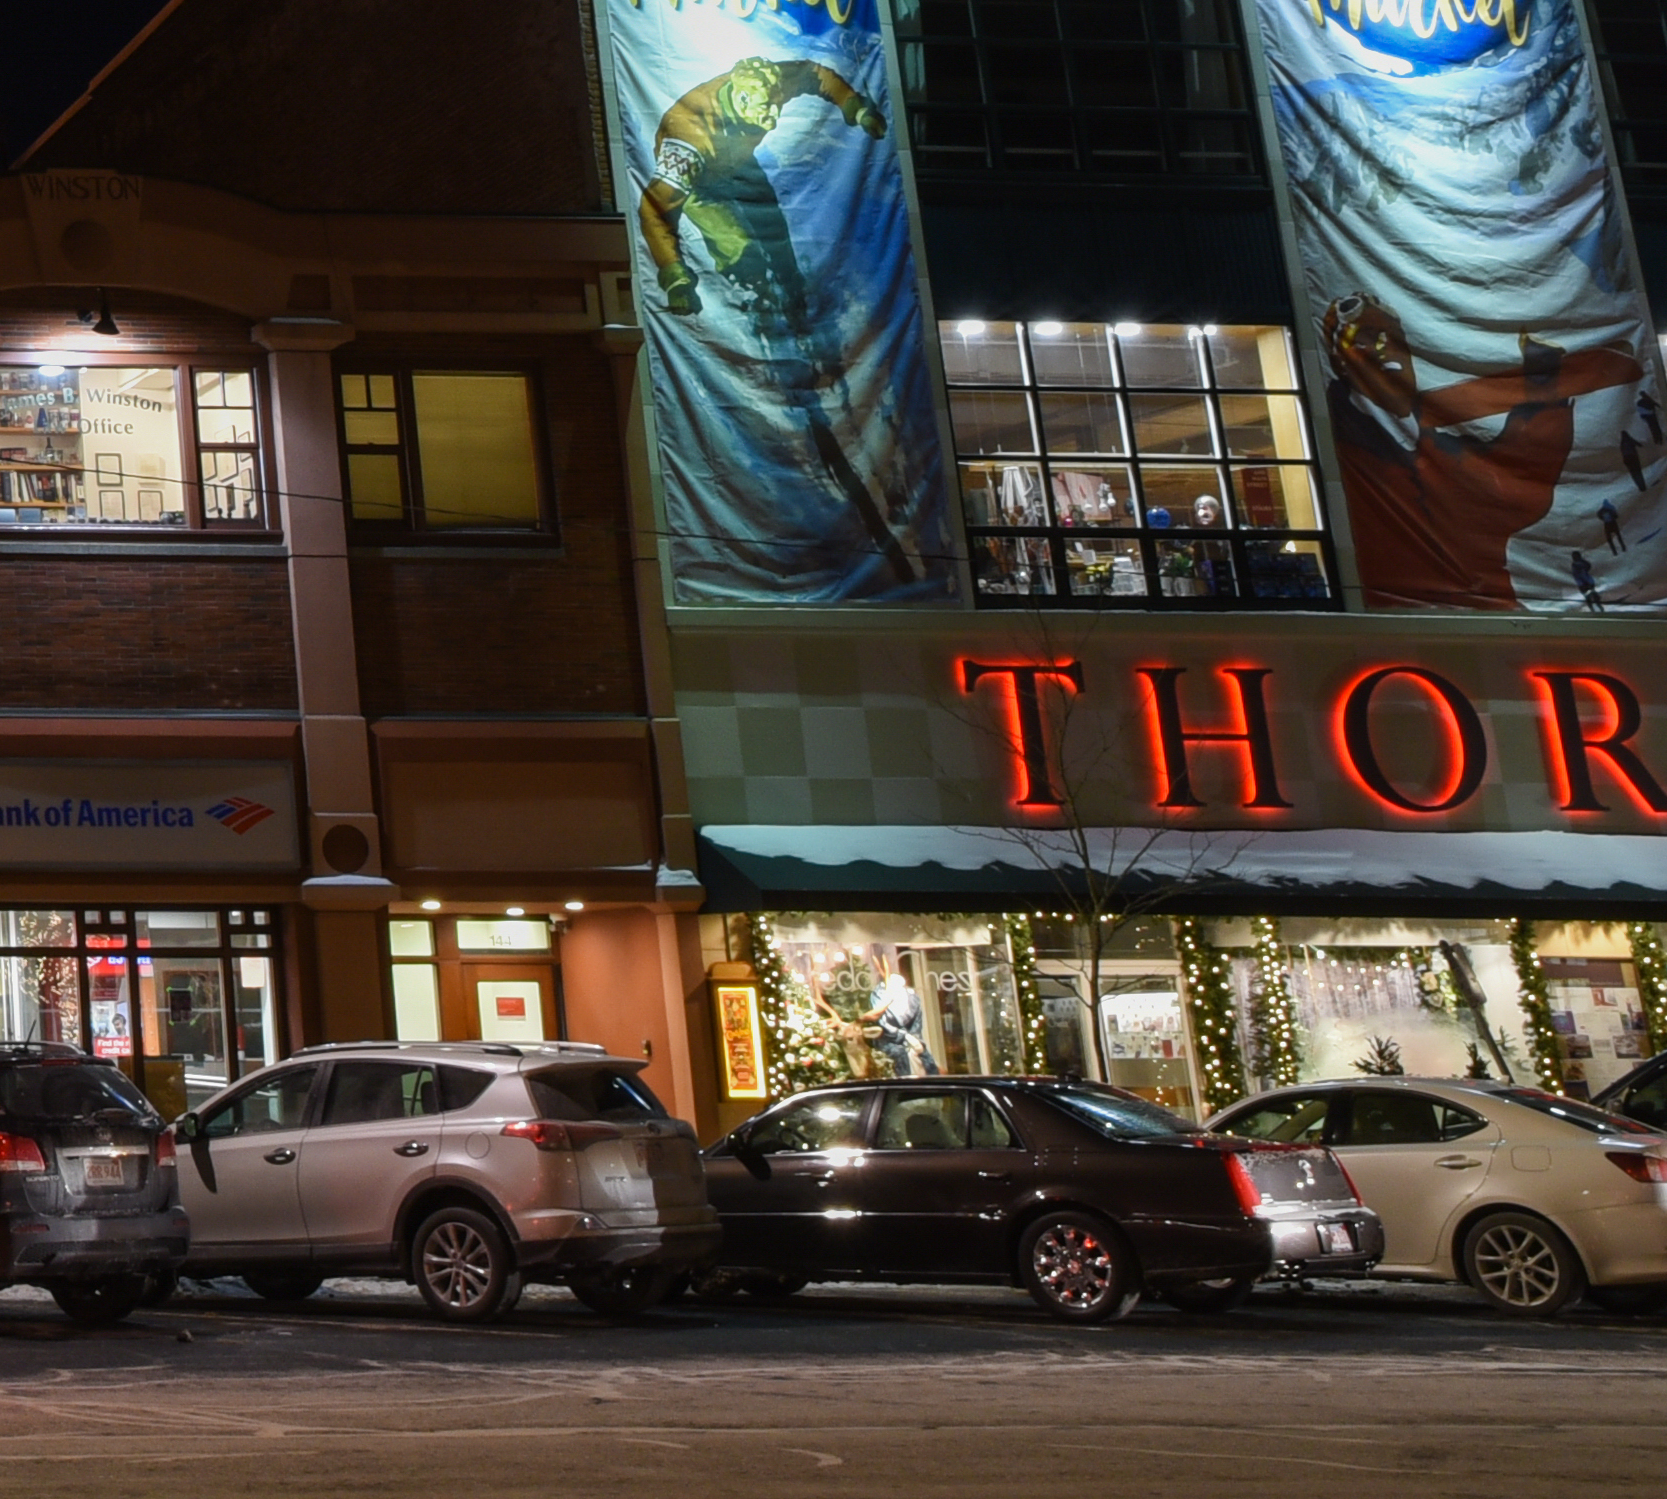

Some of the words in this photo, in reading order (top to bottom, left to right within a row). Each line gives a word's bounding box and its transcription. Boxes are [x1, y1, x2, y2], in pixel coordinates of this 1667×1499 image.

[2, 389, 56, 411] James
[86, 387, 163, 413] Winston
[77, 417, 135, 436] Office
[955, 658, 1667, 814] THOR
[45, 798, 73, 827] of
[77, 799, 195, 828] America
